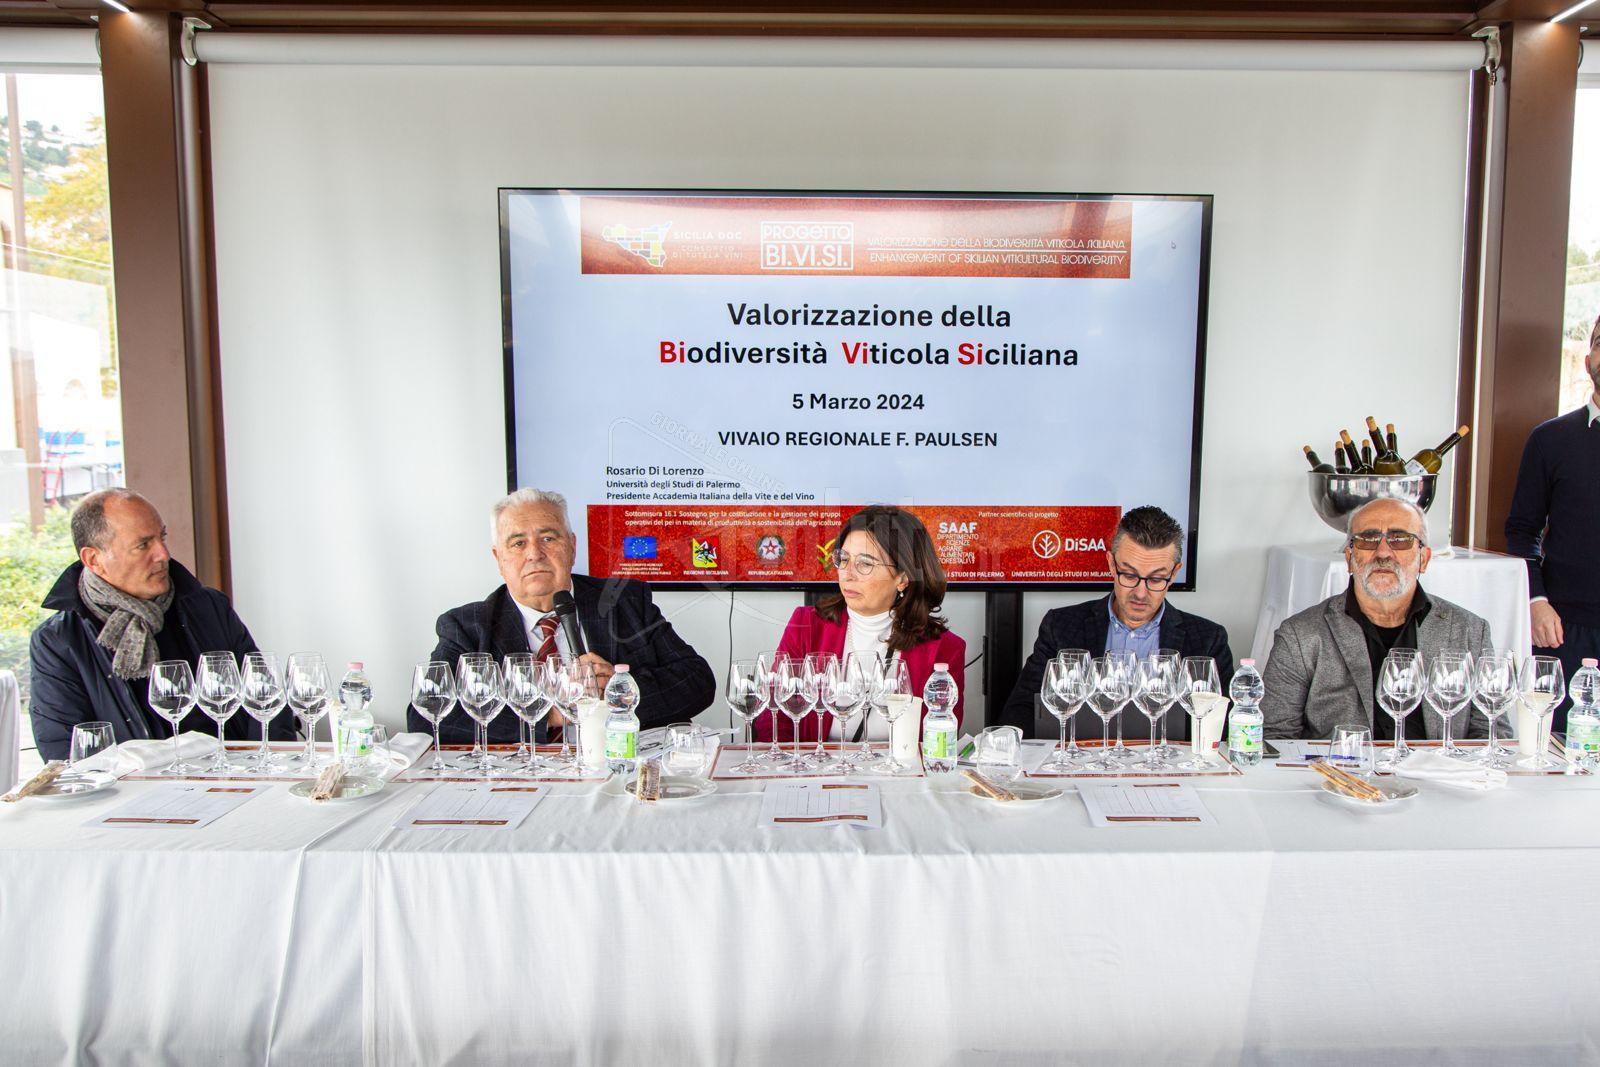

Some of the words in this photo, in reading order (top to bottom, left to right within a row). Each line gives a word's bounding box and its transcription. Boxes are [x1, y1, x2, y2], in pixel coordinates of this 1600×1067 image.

[673, 231, 714, 240] SICILIA
[718, 232, 742, 240] DOC
[764, 225, 850, 240] PROGETTO
[952, 238, 981, 247] DELLA
[1046, 239, 1085, 249] VITICOLA
[1086, 239, 1125, 249] SICILIANA
[766, 243, 849, 267] BI.VI.SI.
[869, 253, 946, 263] ENHANCEMENT
[948, 254, 963, 263] OF
[964, 254, 1000, 264] SICILIAN
[1001, 254, 1059, 264] VITICULTURAL
[1061, 255, 1124, 265] BIODIVERSITY
[727, 303, 933, 327] Valorizzazione
[941, 304, 1011, 327] della
[660, 341, 828, 364] Biodiversità
[841, 342, 949, 365] Viticola
[957, 342, 1079, 366] Siciliana
[792, 393, 804, 409] 5
[809, 393, 871, 410] Marzo
[876, 394, 925, 410] 2024
[718, 431, 780, 446] VIVAIO
[785, 431, 891, 447] REGIONALE
[896, 432, 909, 446] F.
[915, 432, 997, 447] PAULSEN
[606, 465, 646, 476] Rosario
[648, 465, 660, 476] Di
[662, 466, 705, 476] Lorenzo
[606, 480, 648, 488] Università
[650, 480, 671, 490] degli
[672, 480, 694, 489] Studi
[706, 480, 741, 489] Palermo
[606, 492, 651, 500] Presidente
[652, 492, 698, 500] Accademia
[700, 492, 731, 500] Italiana
[732, 492, 753, 500] della
[754, 492, 772, 500] Vite
[795, 492, 815, 501] Vino
[679, 511, 708, 519] Sostegno
[709, 511, 720, 519] per
[781, 511, 808, 519] gestione
[820, 511, 841, 519] gruppi
[624, 519, 653, 527] operativi
[939, 521, 978, 534] SAAF
[1064, 537, 1107, 552] DiSAA
